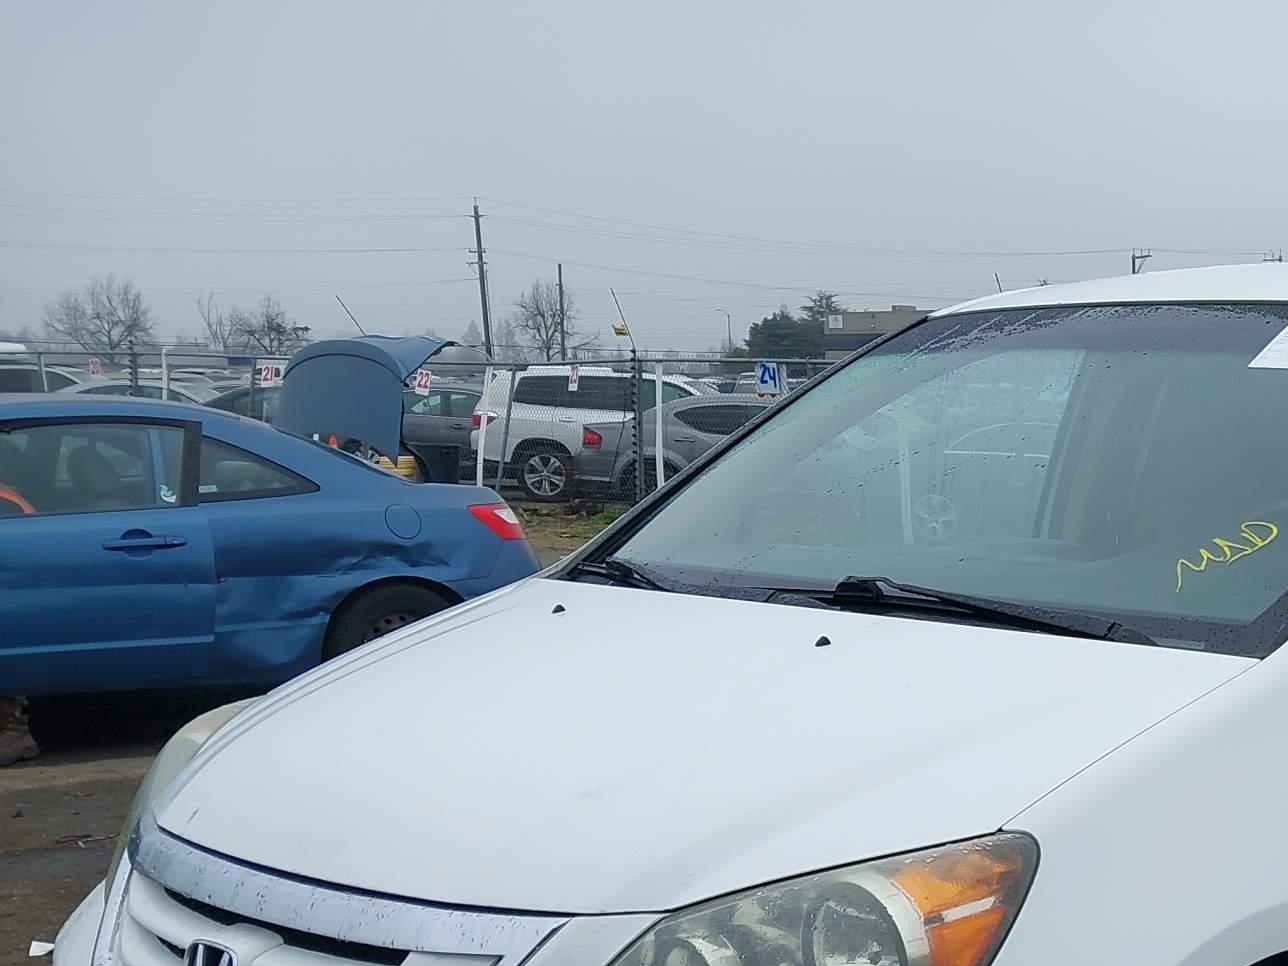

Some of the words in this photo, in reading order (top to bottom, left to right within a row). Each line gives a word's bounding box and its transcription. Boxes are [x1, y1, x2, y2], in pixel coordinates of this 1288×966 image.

[262, 365, 274, 382] 21
[417, 371, 430, 388] 22
[760, 363, 777, 388] 24
